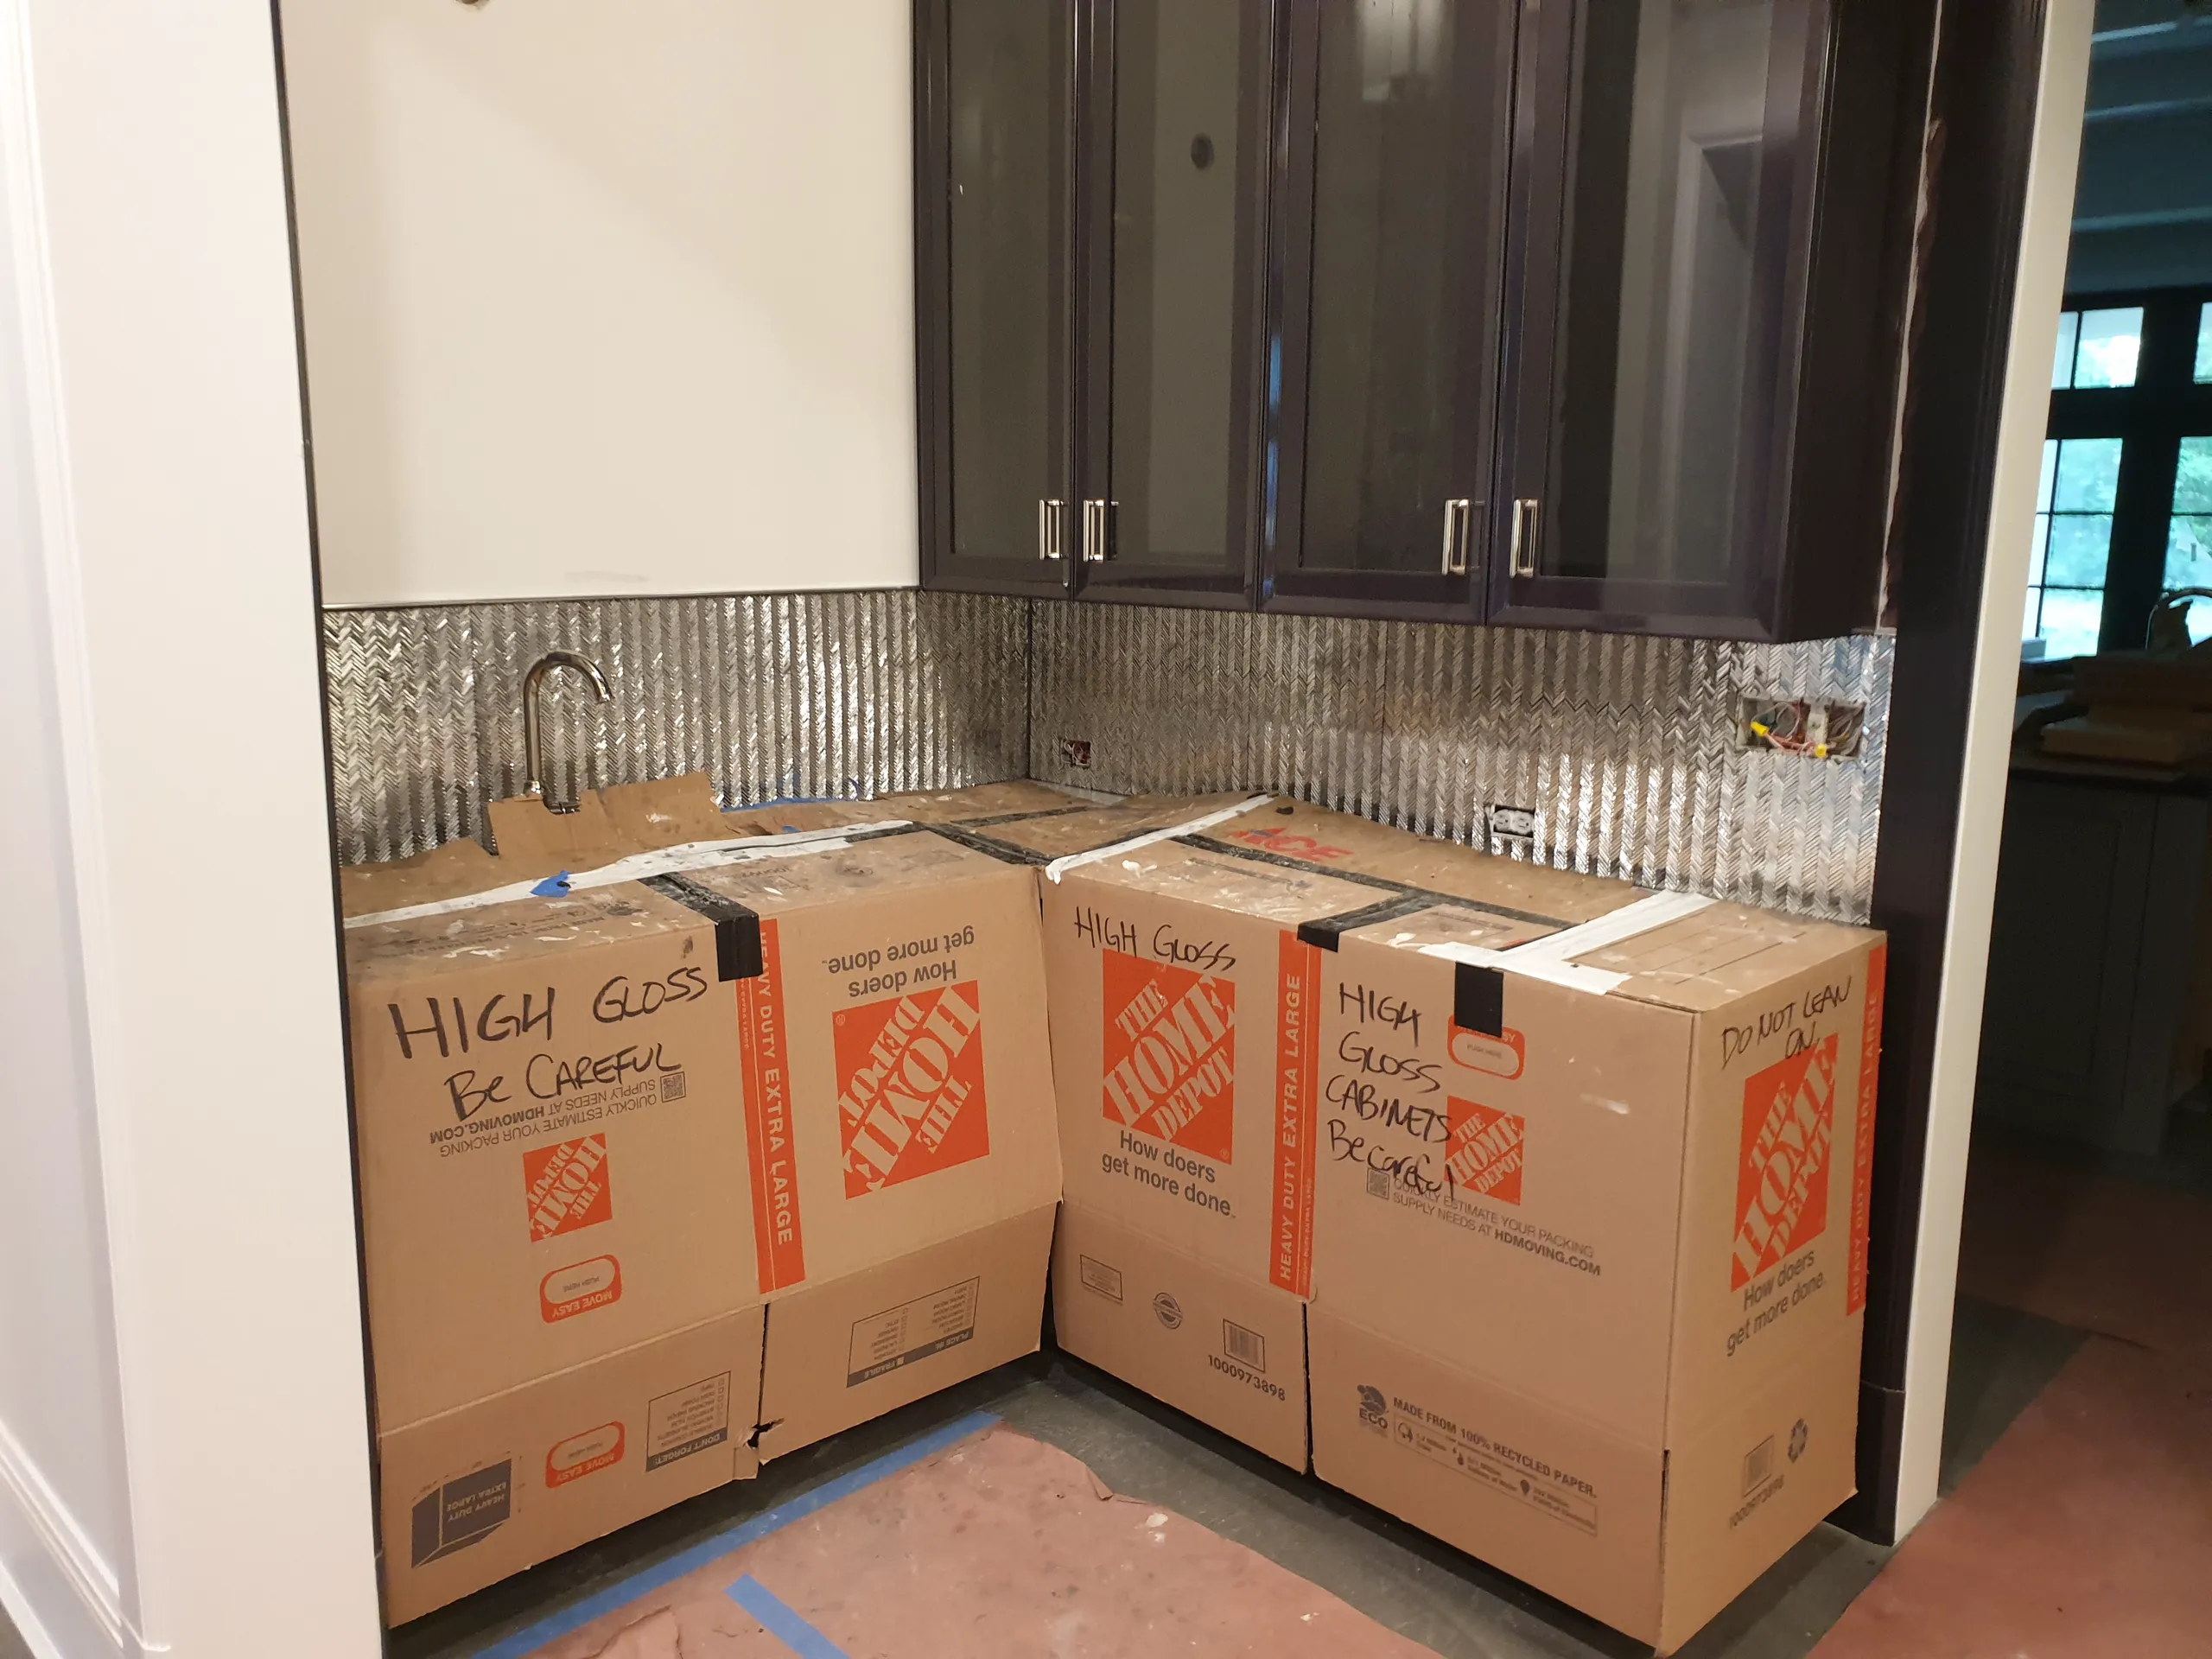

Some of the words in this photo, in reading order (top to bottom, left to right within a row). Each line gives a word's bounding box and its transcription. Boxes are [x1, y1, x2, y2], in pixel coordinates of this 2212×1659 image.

[887, 937, 938, 961] more
[944, 925, 975, 953] get
[1074, 906, 1137, 958] HIGH
[1154, 924, 1236, 970] GLOSS
[849, 970, 907, 997] doers
[913, 960, 957, 983] How
[387, 987, 556, 1058] HIGH
[593, 966, 708, 1023] GLOSS
[759, 1005, 776, 1058] DUTY
[1115, 978, 1168, 1041] THE
[1285, 974, 1300, 1058] LARGE
[1339, 982, 1422, 1047] HIGH
[1721, 1025, 1753, 1071] DO
[1758, 1001, 1796, 1046] NOT
[1803, 976, 1852, 1019] LEAN
[838, 996, 925, 1127] DEPOT
[1103, 975, 1236, 1127] HOME
[1338, 1031, 1443, 1093] GLOSS
[444, 1070, 512, 1122] Be
[525, 1043, 682, 1098] CAREFUL
[548, 1102, 563, 1116] AT
[566, 1090, 607, 1111] NEEDS
[606, 1093, 658, 1116] QUICKLY
[610, 1079, 656, 1099] SUPPLY
[765, 1068, 785, 1153] EXTRA
[843, 987, 980, 1191] HOME
[1152, 1047, 1234, 1141] DEPOT
[1283, 1067, 1298, 1147] EXTRA
[1325, 1074, 1453, 1143] CABINETS
[429, 1105, 544, 1144] HDMOVING.COM
[440, 1133, 499, 1157] PACKING
[505, 1123, 541, 1142] YOUR
[543, 1106, 603, 1131] ESTIMATE
[915, 1076, 971, 1153] THE
[1452, 1113, 1487, 1143] THE
[1749, 1081, 1792, 1173] THE
[527, 1143, 575, 1208] DEPOT
[1102, 1153, 1129, 1177] get
[1135, 1165, 1179, 1196] more
[1120, 1130, 1158, 1161] How
[1163, 1147, 1216, 1183] doers
[1445, 1112, 1523, 1186] HOME
[1473, 1147, 1522, 1194] DEPOT
[1733, 1037, 1835, 1280] HOME
[530, 1136, 607, 1238] HOME
[570, 1180, 602, 1220] THE
[770, 1160, 793, 1246] LARGE
[1282, 1156, 1296, 1210] DUTY
[1770, 1110, 1831, 1259] DEPOT
[1280, 1217, 1294, 1281] HEAVY
[1393, 1192, 1436, 1216] SUPPLY
[1438, 1207, 1476, 1231] NEEDS
[1478, 1224, 1493, 1236] AT
[1494, 1228, 1601, 1276] HDMOVING.COM
[1444, 1196, 1498, 1224] ESTIMATE
[1501, 1215, 1536, 1239] YOUR
[1539, 1229, 1594, 1259] PACKING
[552, 1300, 581, 1319] EASY
[582, 1290, 613, 1306] MOVE
[1744, 1276, 1775, 1312] How
[1777, 1250, 1815, 1287] doers
[1726, 1318, 1751, 1357] get
[1753, 1296, 1789, 1333] more
[1208, 1354, 1286, 1402] 1000973898
[1358, 1408, 1389, 1430] ECO
[1393, 1396, 1424, 1419] MADE
[1426, 1412, 1457, 1435] FROM
[1461, 1427, 1491, 1451] 100%
[1493, 1441, 1551, 1478] RECYCLED
[448, 1507, 474, 1523] DUTY
[475, 1493, 505, 1511] HEAVY
[478, 1481, 507, 1497] EXTRA
